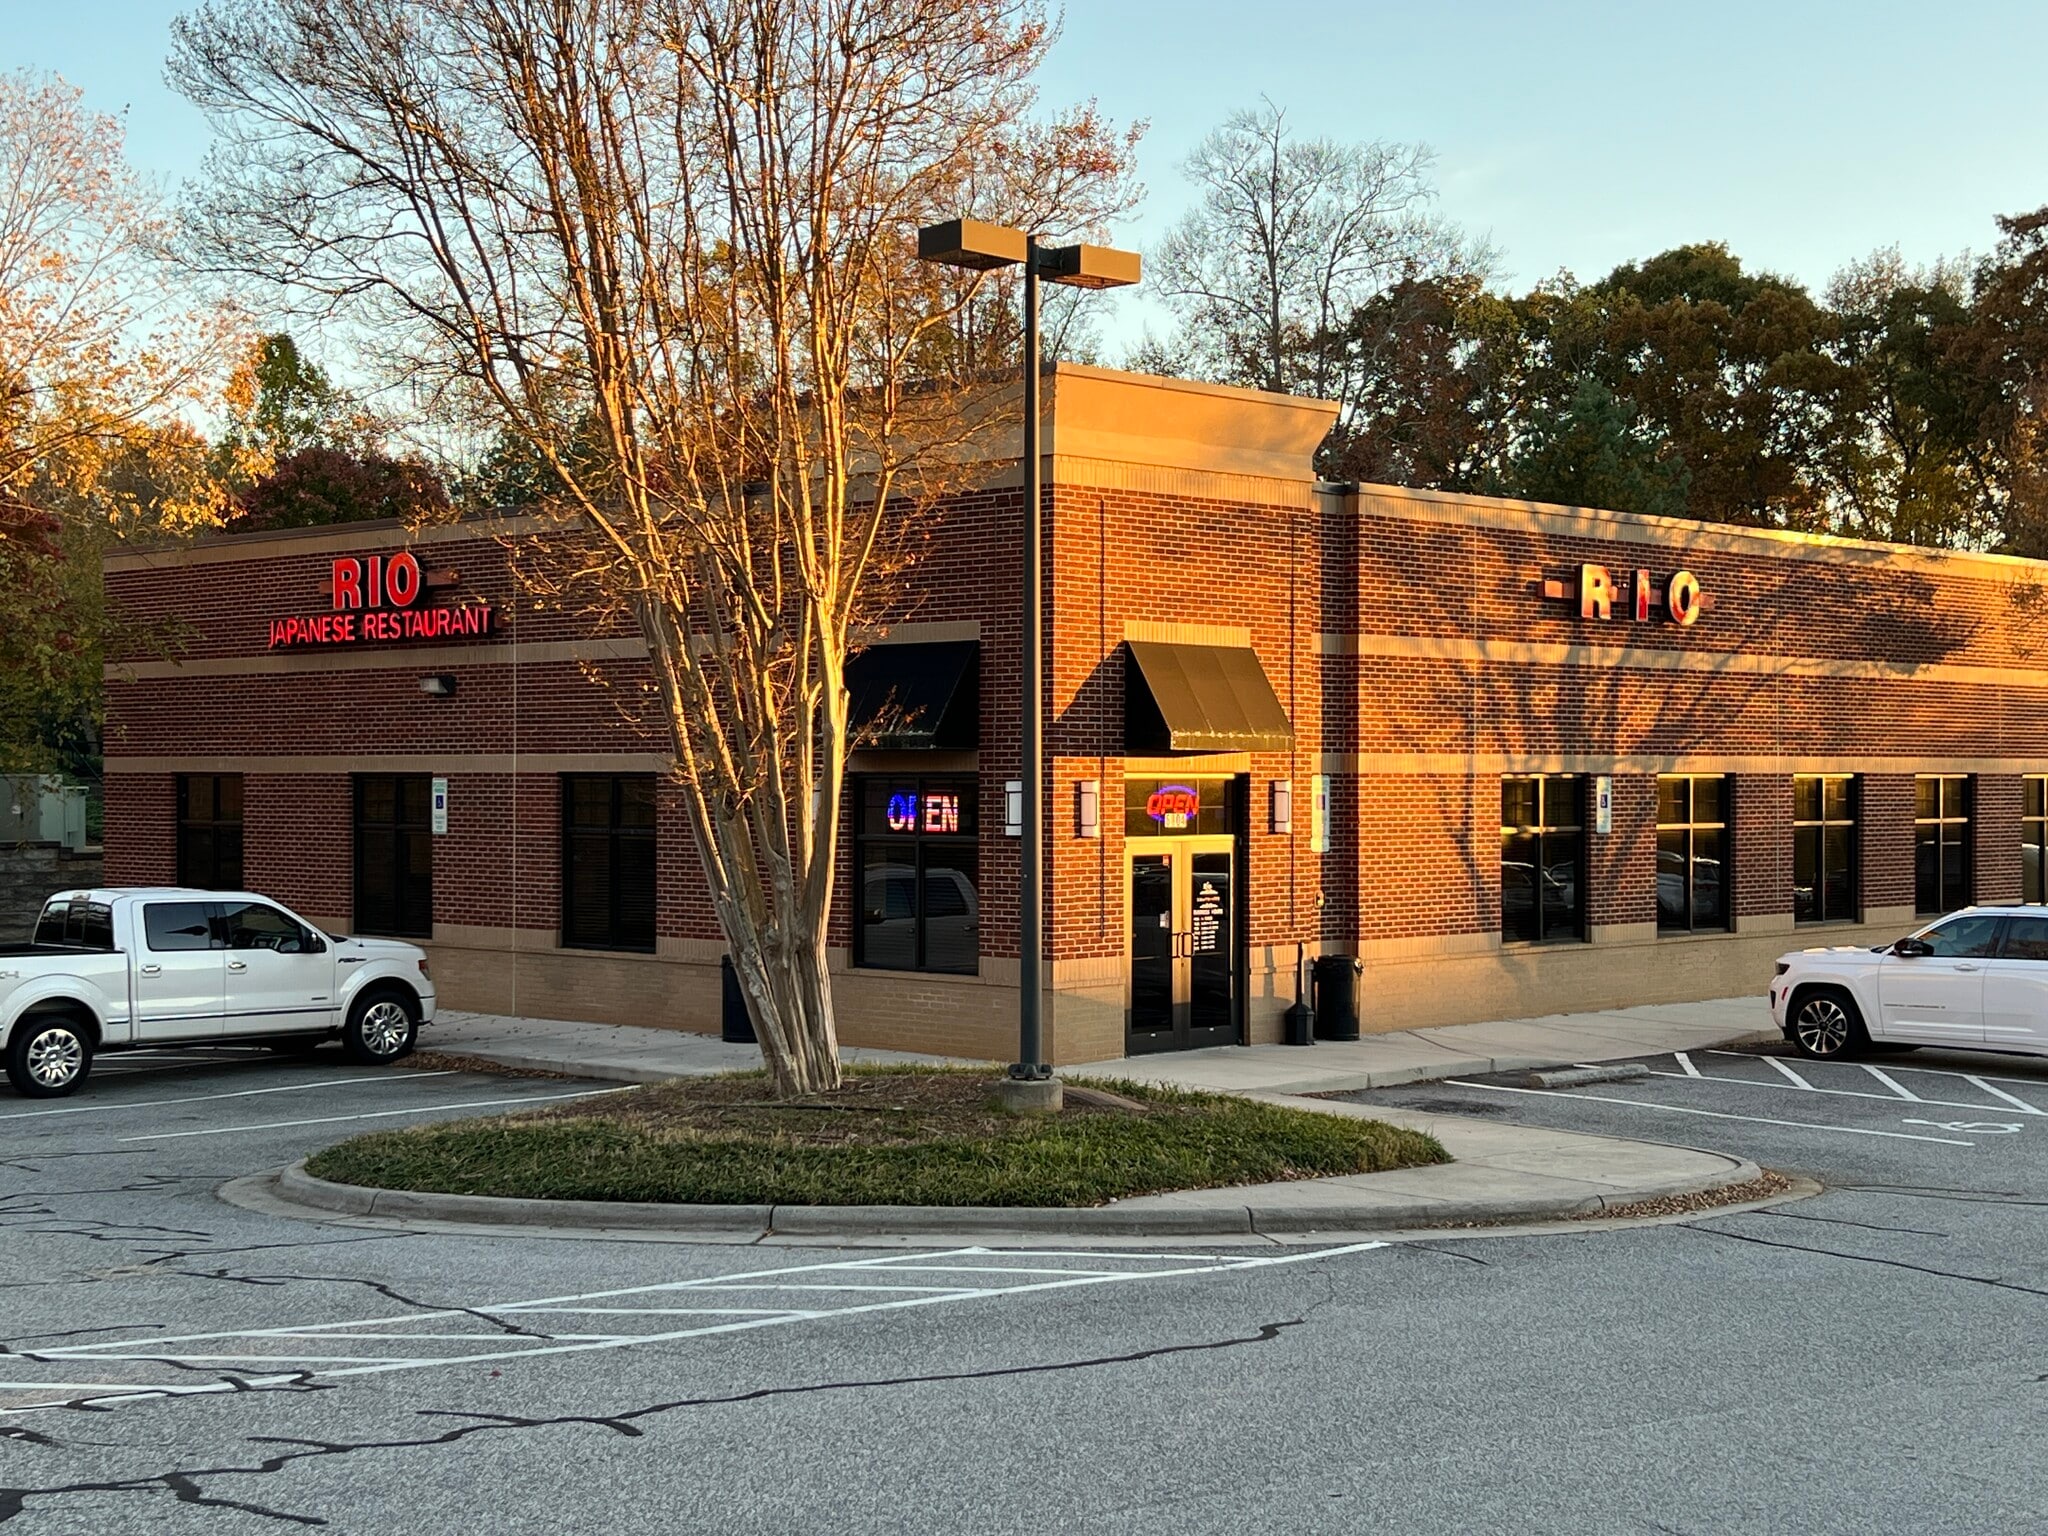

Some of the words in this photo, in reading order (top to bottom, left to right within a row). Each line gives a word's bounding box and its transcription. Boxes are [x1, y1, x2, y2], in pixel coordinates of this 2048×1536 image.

[333, 551, 420, 609] RIO
[1581, 563, 1700, 626] RIO
[268, 614, 355, 650] JAPANESE
[363, 607, 492, 640] RESTAURANT
[1146, 793, 1200, 816] OPEN
